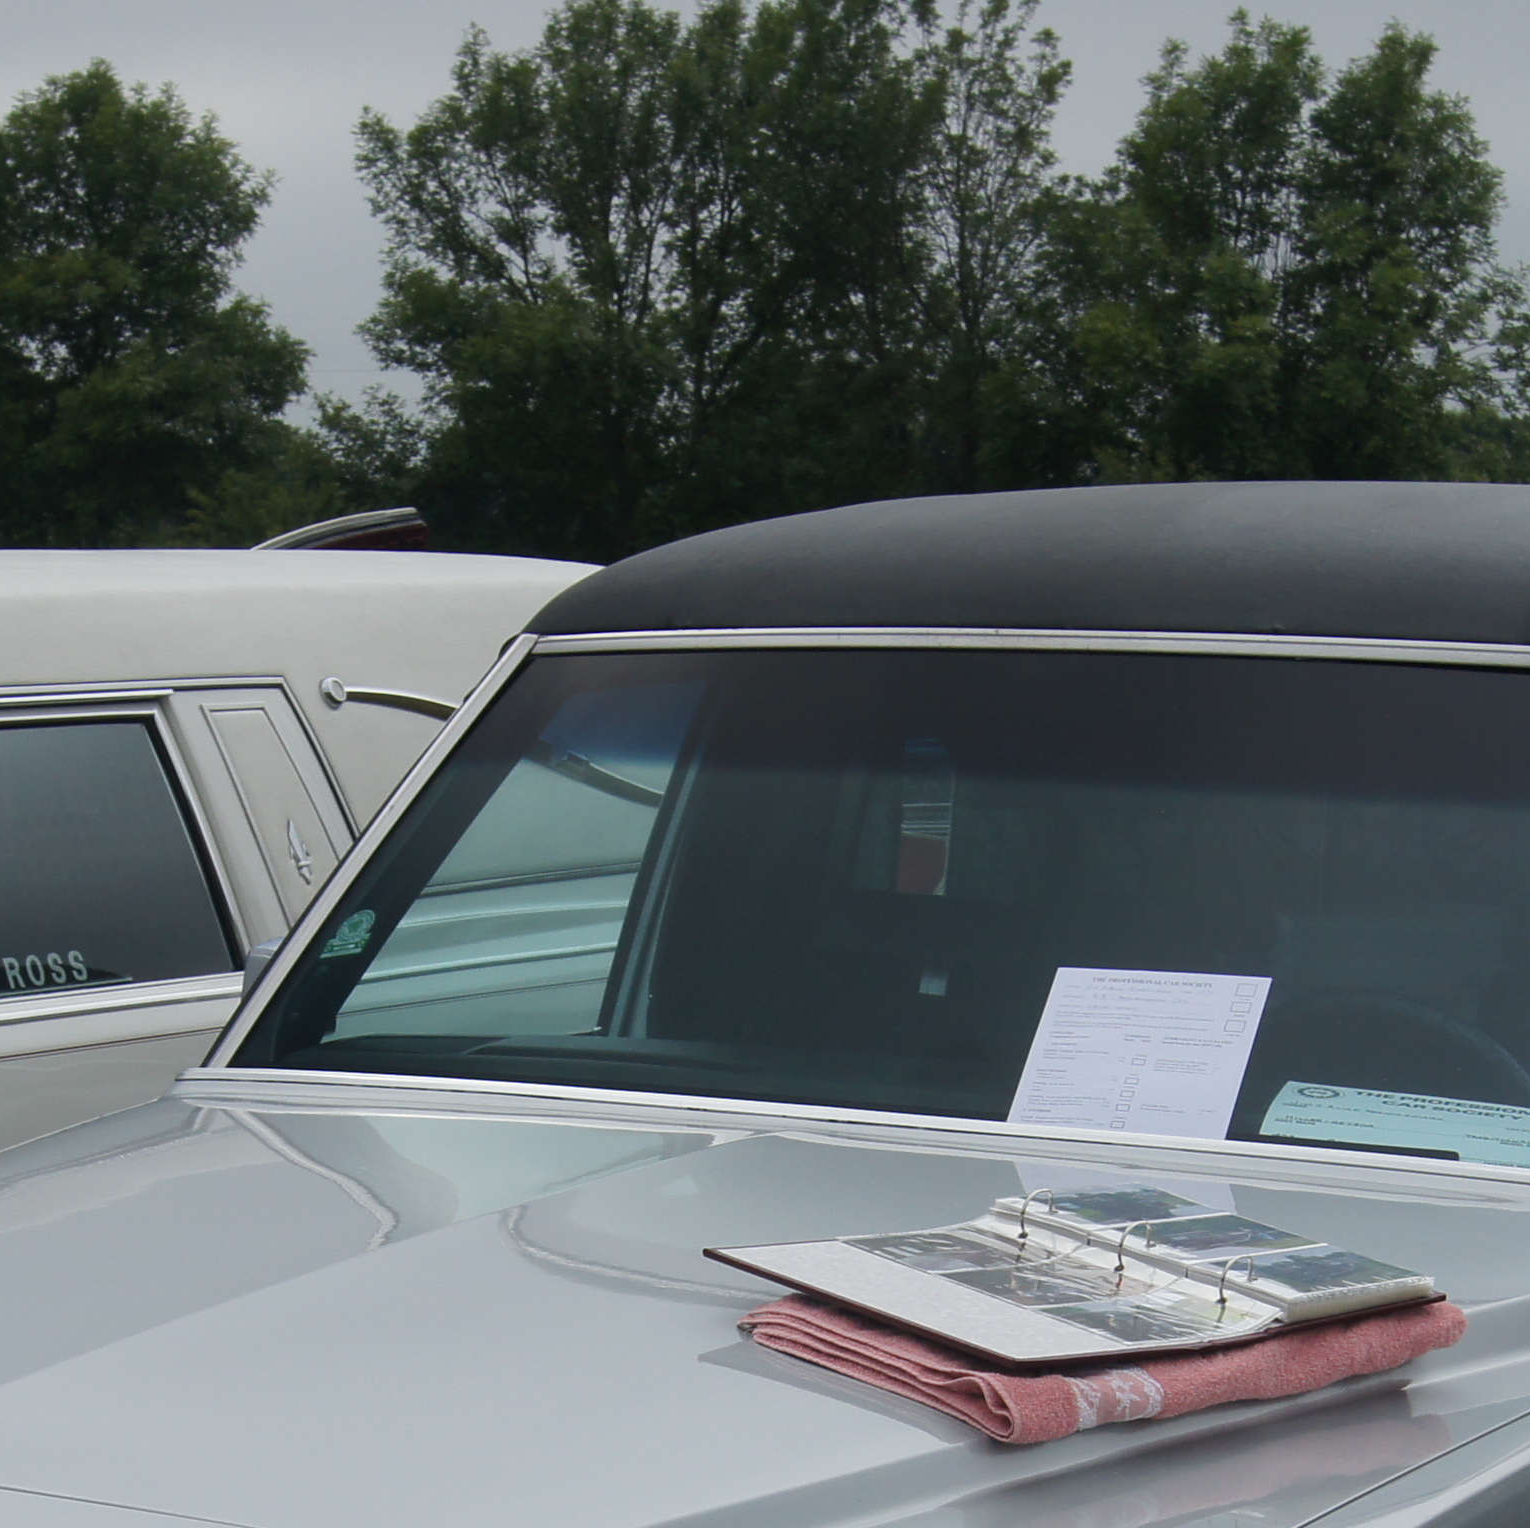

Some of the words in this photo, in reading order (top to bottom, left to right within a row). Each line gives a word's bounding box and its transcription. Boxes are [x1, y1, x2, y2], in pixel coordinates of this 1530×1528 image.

[2, 950, 88, 989] ROSS
[1354, 1090, 1395, 1100] THE
[1381, 1100, 1427, 1110] CAR
[1432, 1105, 1524, 1120] SOCIETY
